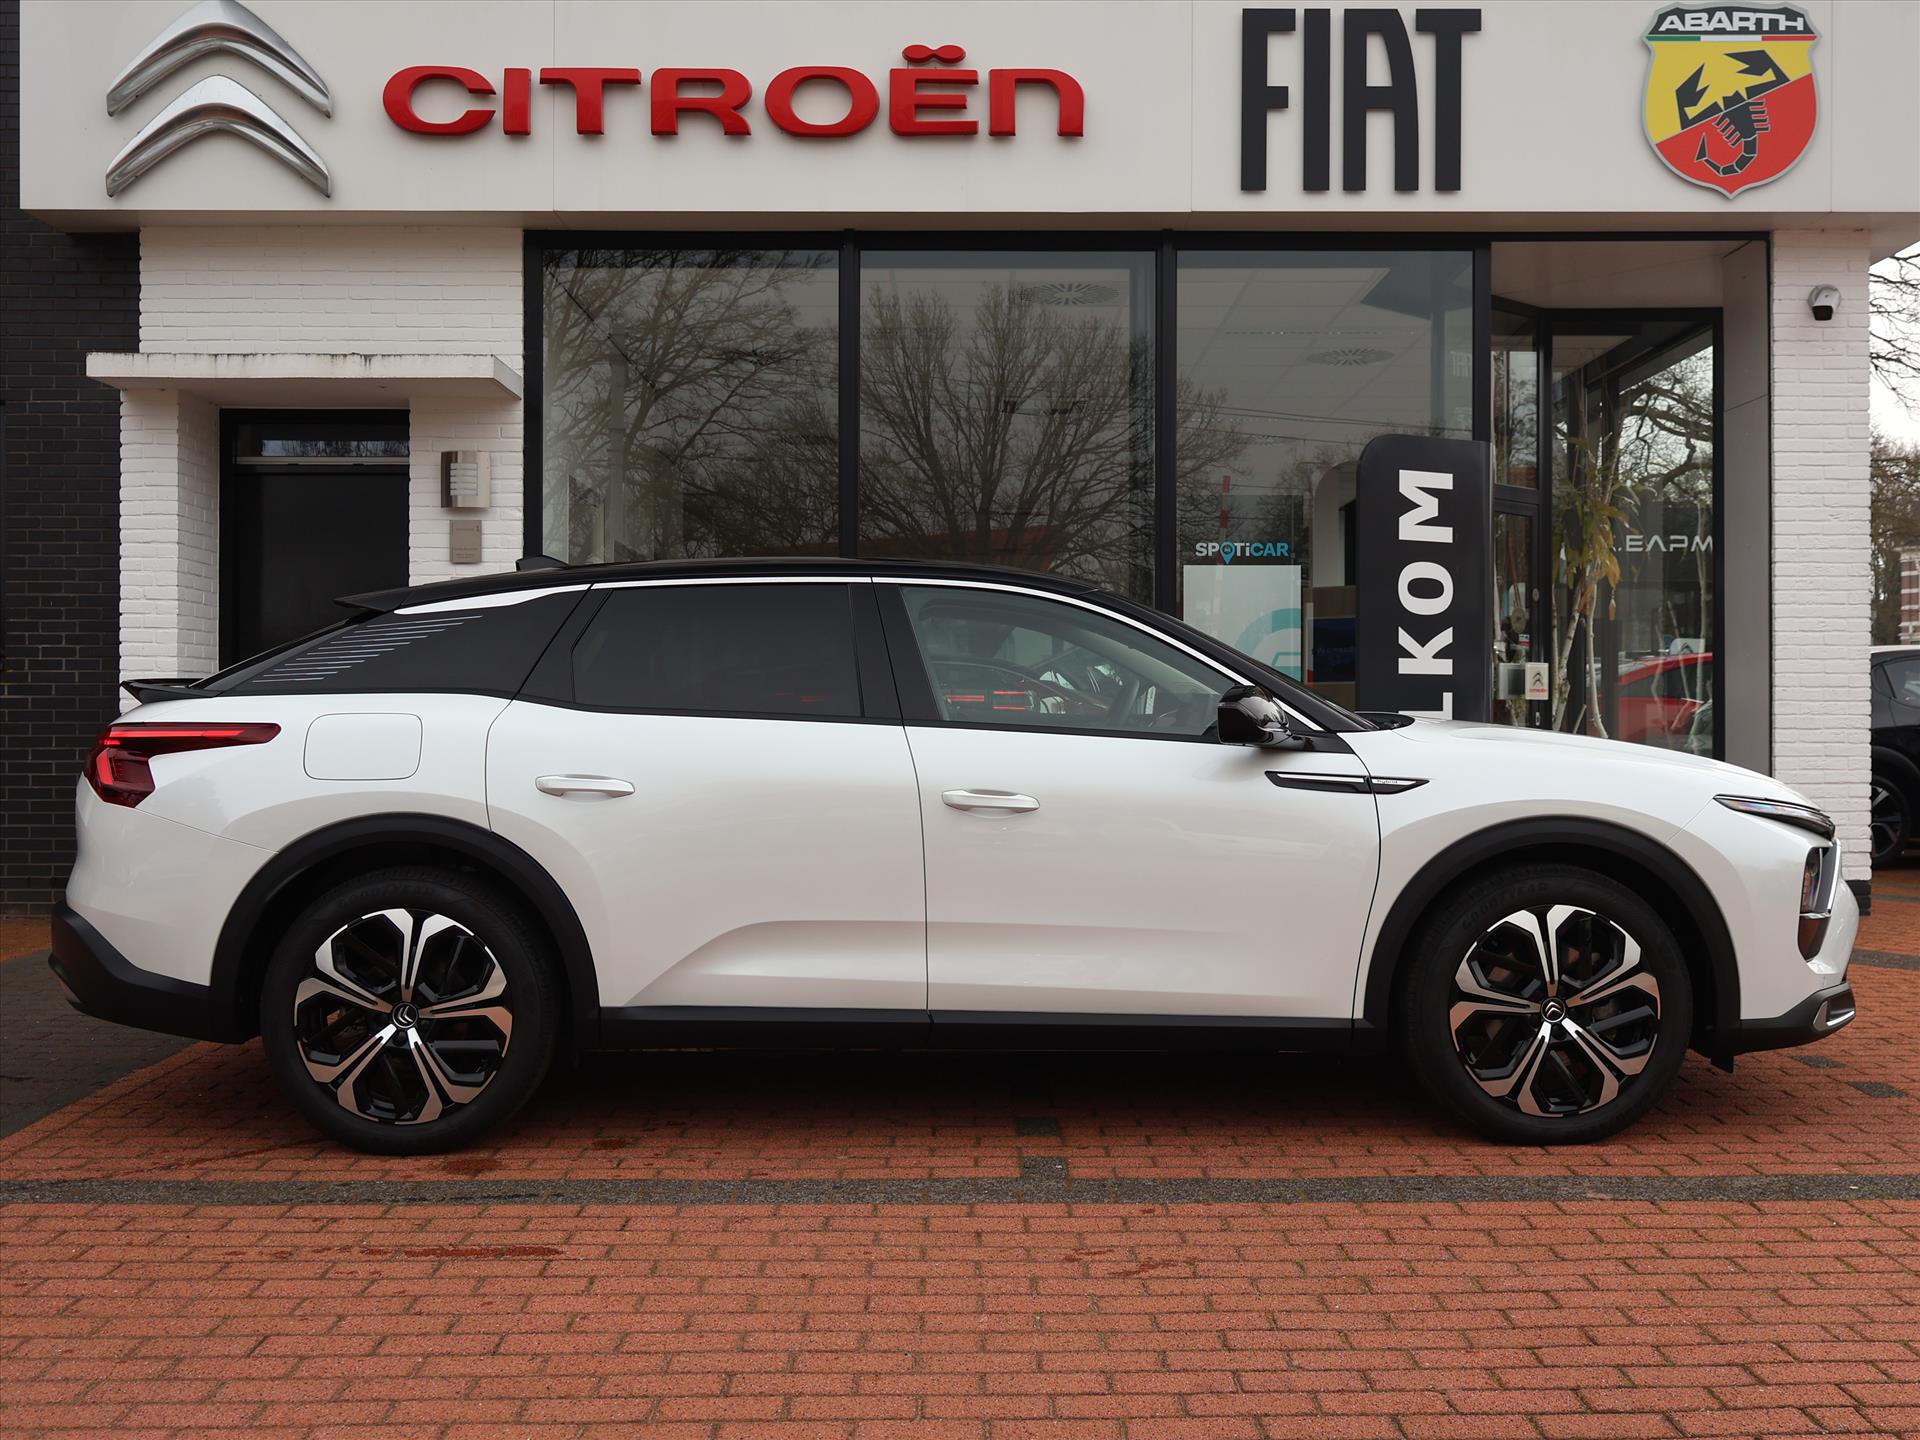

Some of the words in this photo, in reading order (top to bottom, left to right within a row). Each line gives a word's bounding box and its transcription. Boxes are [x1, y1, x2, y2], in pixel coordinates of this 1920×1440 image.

[1658, 11, 1804, 32] ABARTH
[382, 44, 1085, 138] CITROËN
[1240, 8, 1482, 191] FIAT
